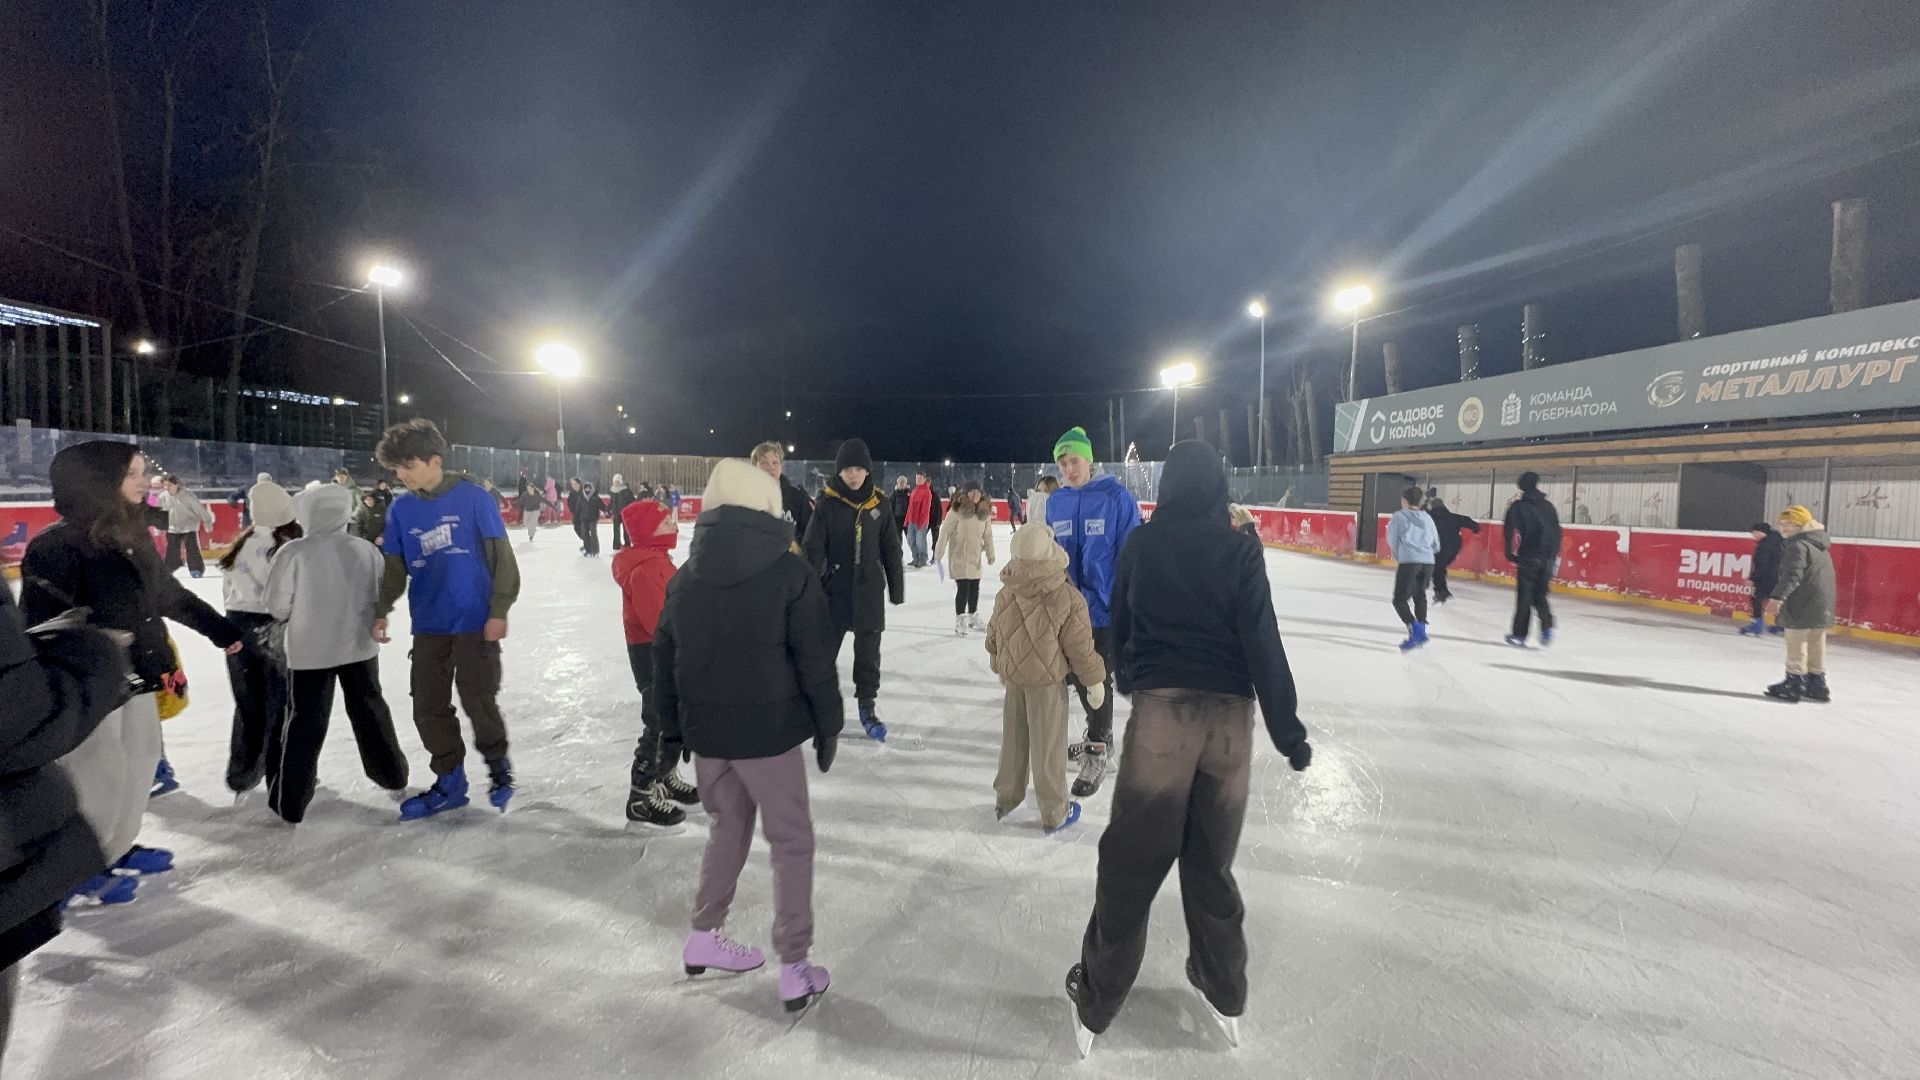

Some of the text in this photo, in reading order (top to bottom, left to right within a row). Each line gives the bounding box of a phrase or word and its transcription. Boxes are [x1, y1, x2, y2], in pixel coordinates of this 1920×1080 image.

[1702, 335, 1920, 377] спортивный комплекс
[1695, 354, 1918, 404] МЕТАЛЛУРГ
[1529, 385, 1593, 406] КОМАНДА
[1389, 404, 1445, 424] САДОВОЕ
[1528, 400, 1618, 423] ГУБЕРНАТОРА
[1389, 422, 1436, 440] КОЛЬЦО
[1679, 548, 1753, 579] ЗИМ
[1677, 578, 1685, 588] В
